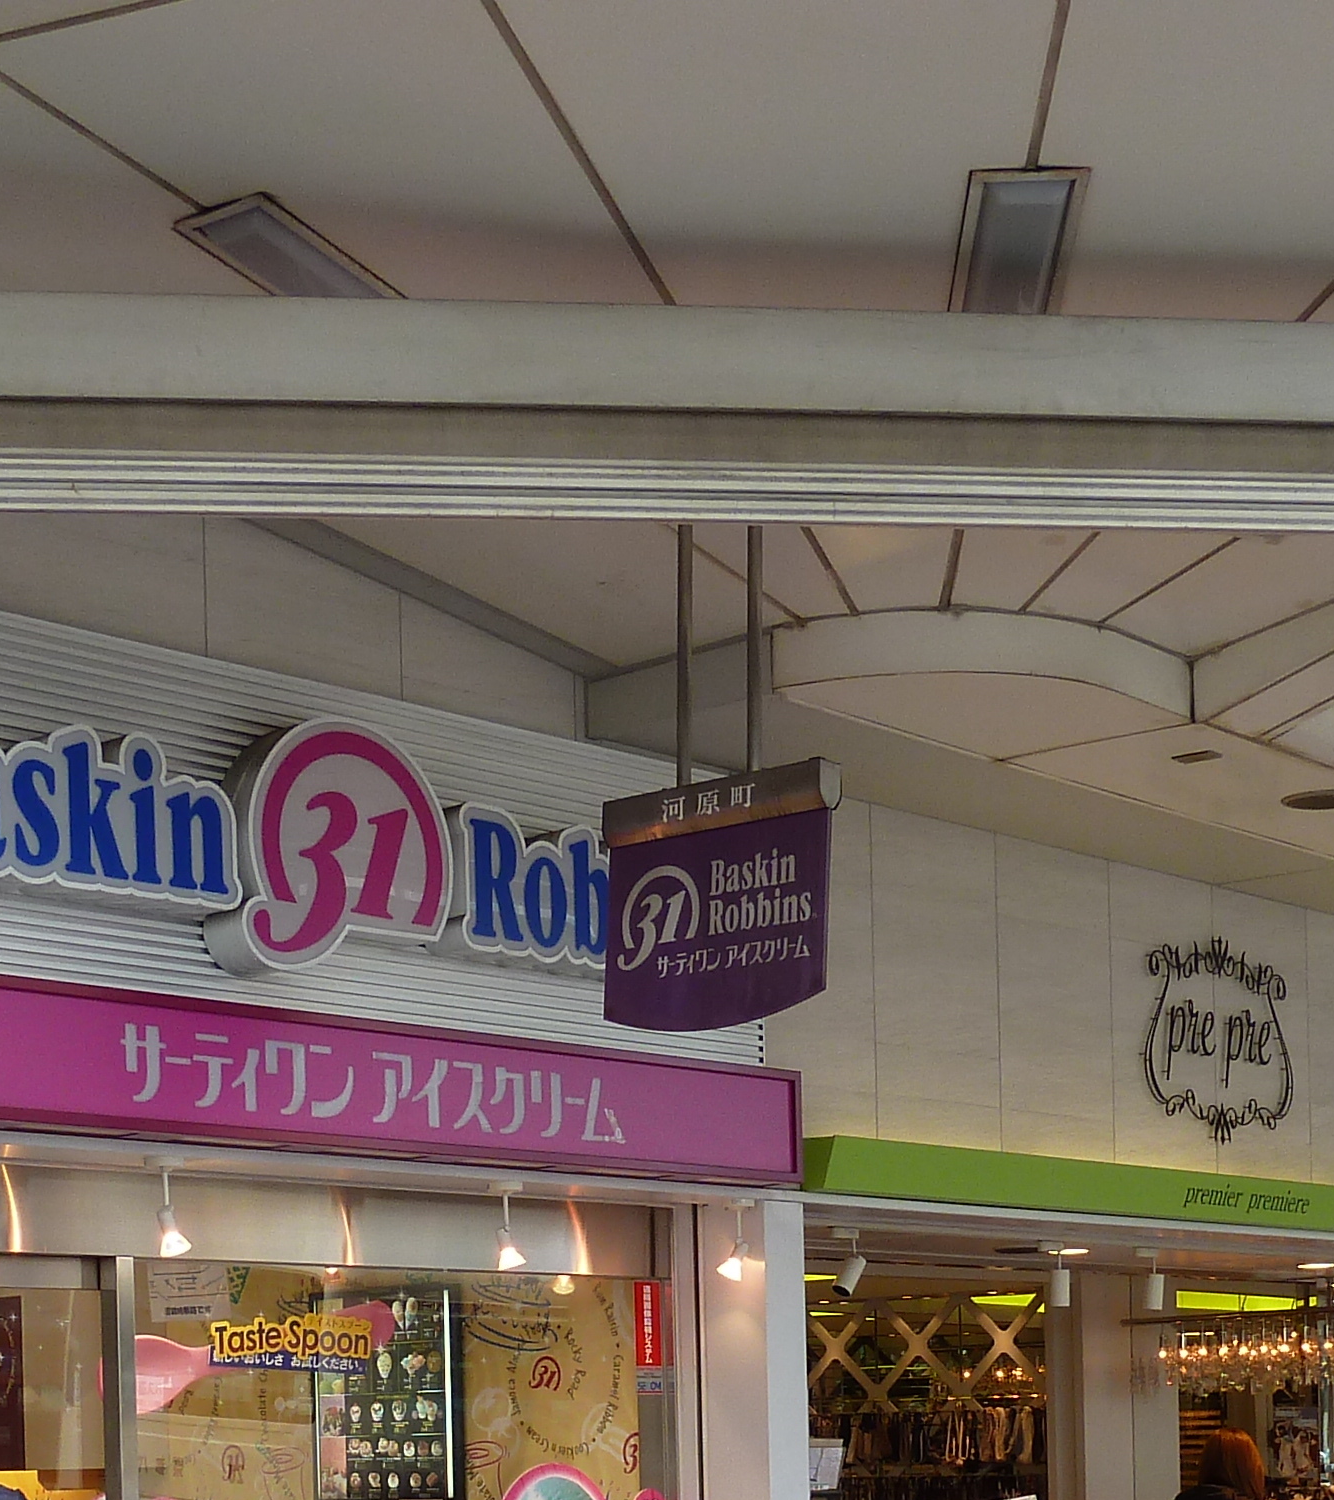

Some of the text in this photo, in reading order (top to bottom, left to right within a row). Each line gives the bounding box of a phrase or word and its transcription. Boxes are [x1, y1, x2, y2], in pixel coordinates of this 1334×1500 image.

[660, 783, 756, 823] 河原町
[252, 762, 417, 954] 31
[710, 847, 796, 897] Baskin
[617, 876, 812, 972] 31 Robbins
[657, 935, 811, 979] サーティワン アイスクリーム
[1166, 1000, 1273, 1090] pre pre
[123, 1022, 626, 1146] サーティワン アイスクリーム
[1183, 1182, 1311, 1216] premier premiere
[214, 1318, 369, 1356] Taste Spoon
[637, 1381, 662, 1391] SEOM
